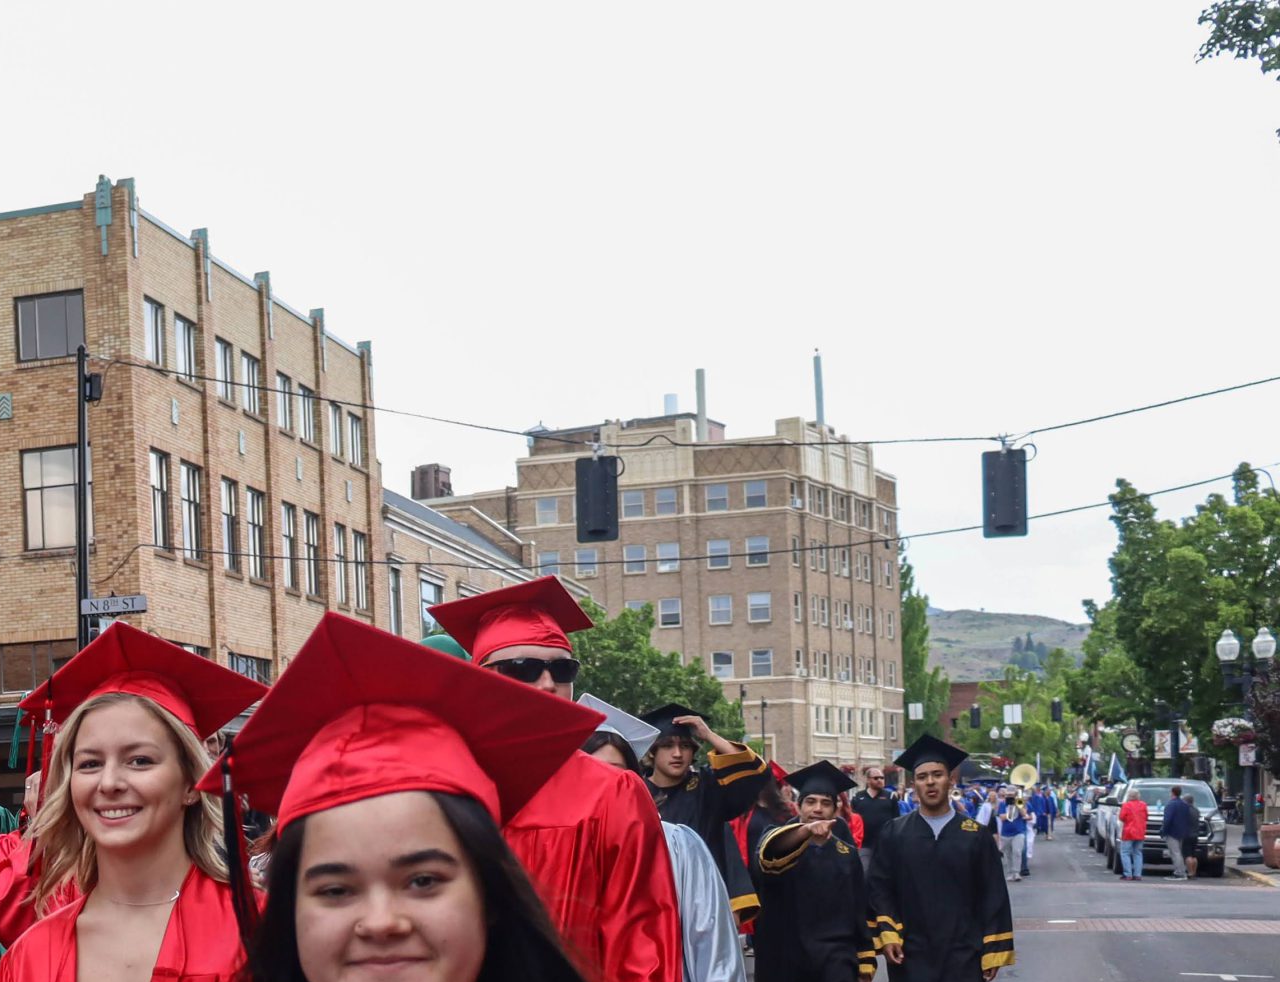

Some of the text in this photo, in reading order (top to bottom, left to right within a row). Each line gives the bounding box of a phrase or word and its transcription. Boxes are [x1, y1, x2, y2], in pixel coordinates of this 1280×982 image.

[90, 597, 137, 611] N 8TH ST
